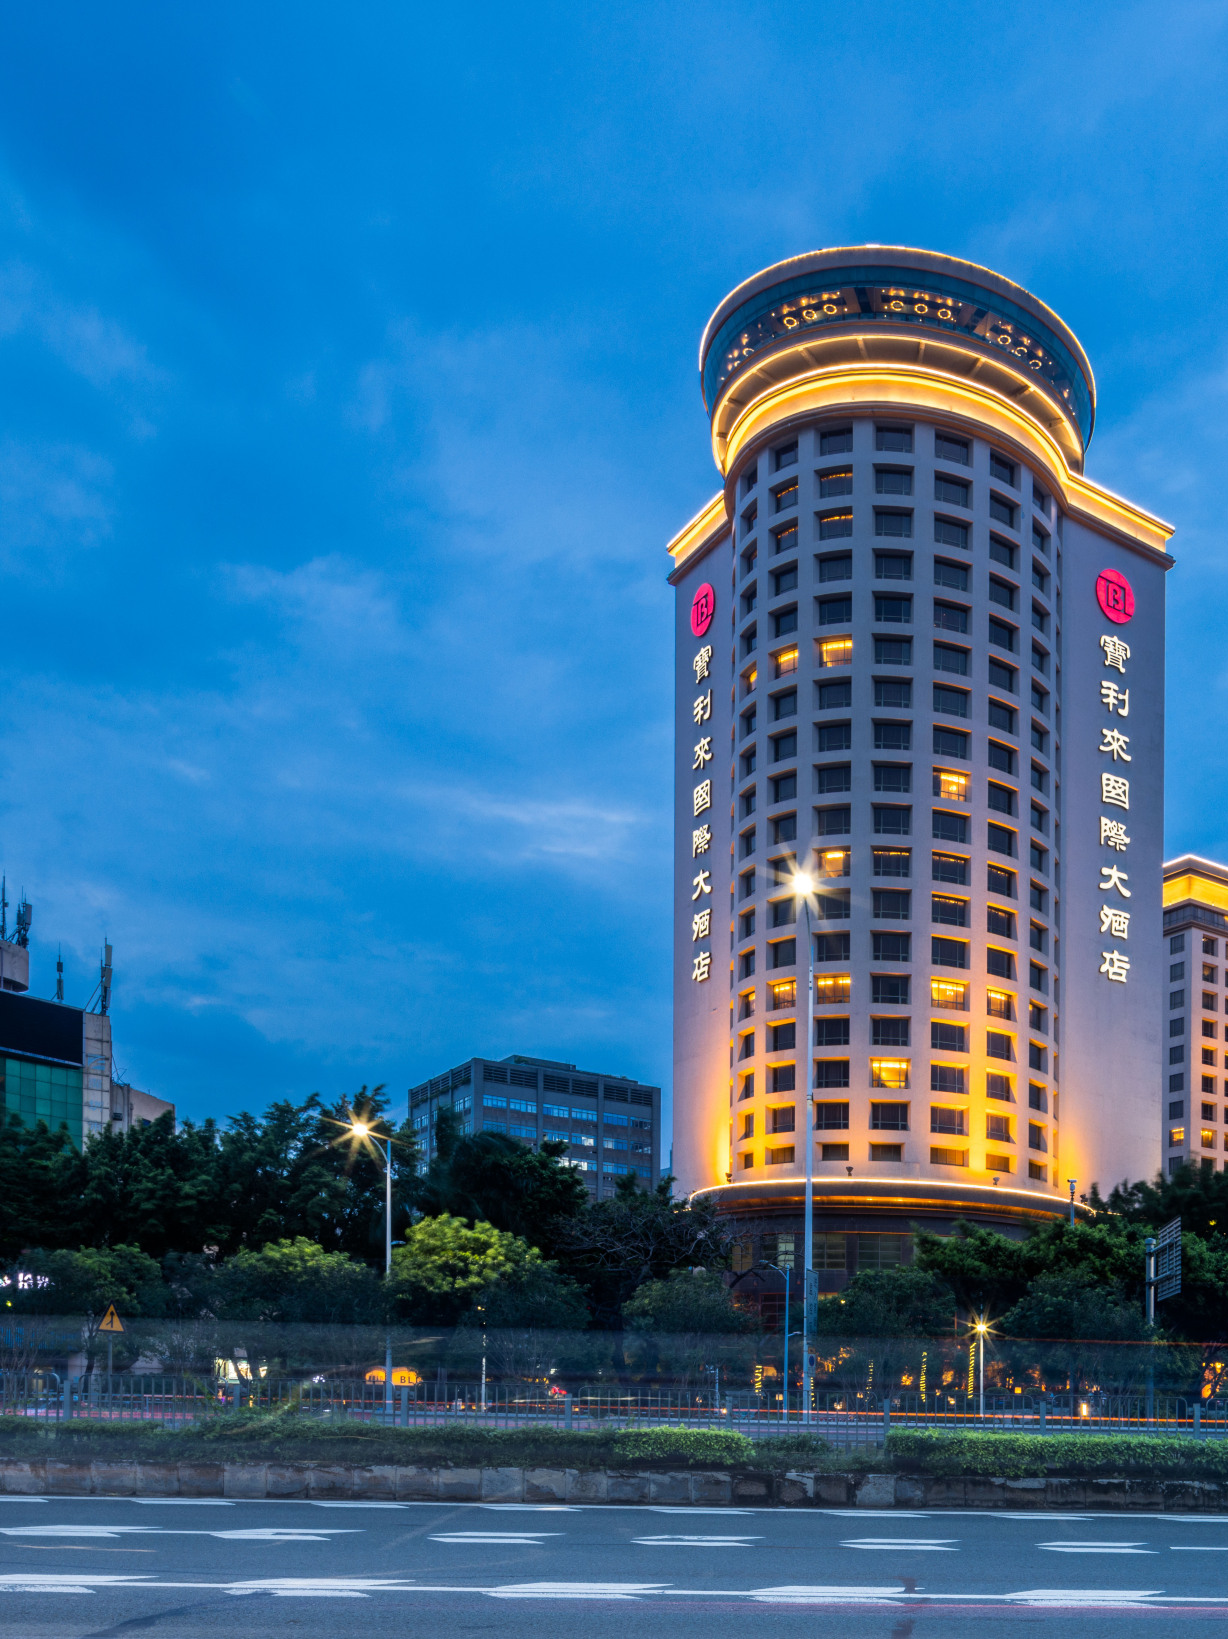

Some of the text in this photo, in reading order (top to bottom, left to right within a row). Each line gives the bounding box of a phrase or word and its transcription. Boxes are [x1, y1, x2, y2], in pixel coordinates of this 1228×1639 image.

[691, 644, 712, 982] 寶利來國際大酒店
[1099, 634, 1132, 983] 寶利來國際大酒店
